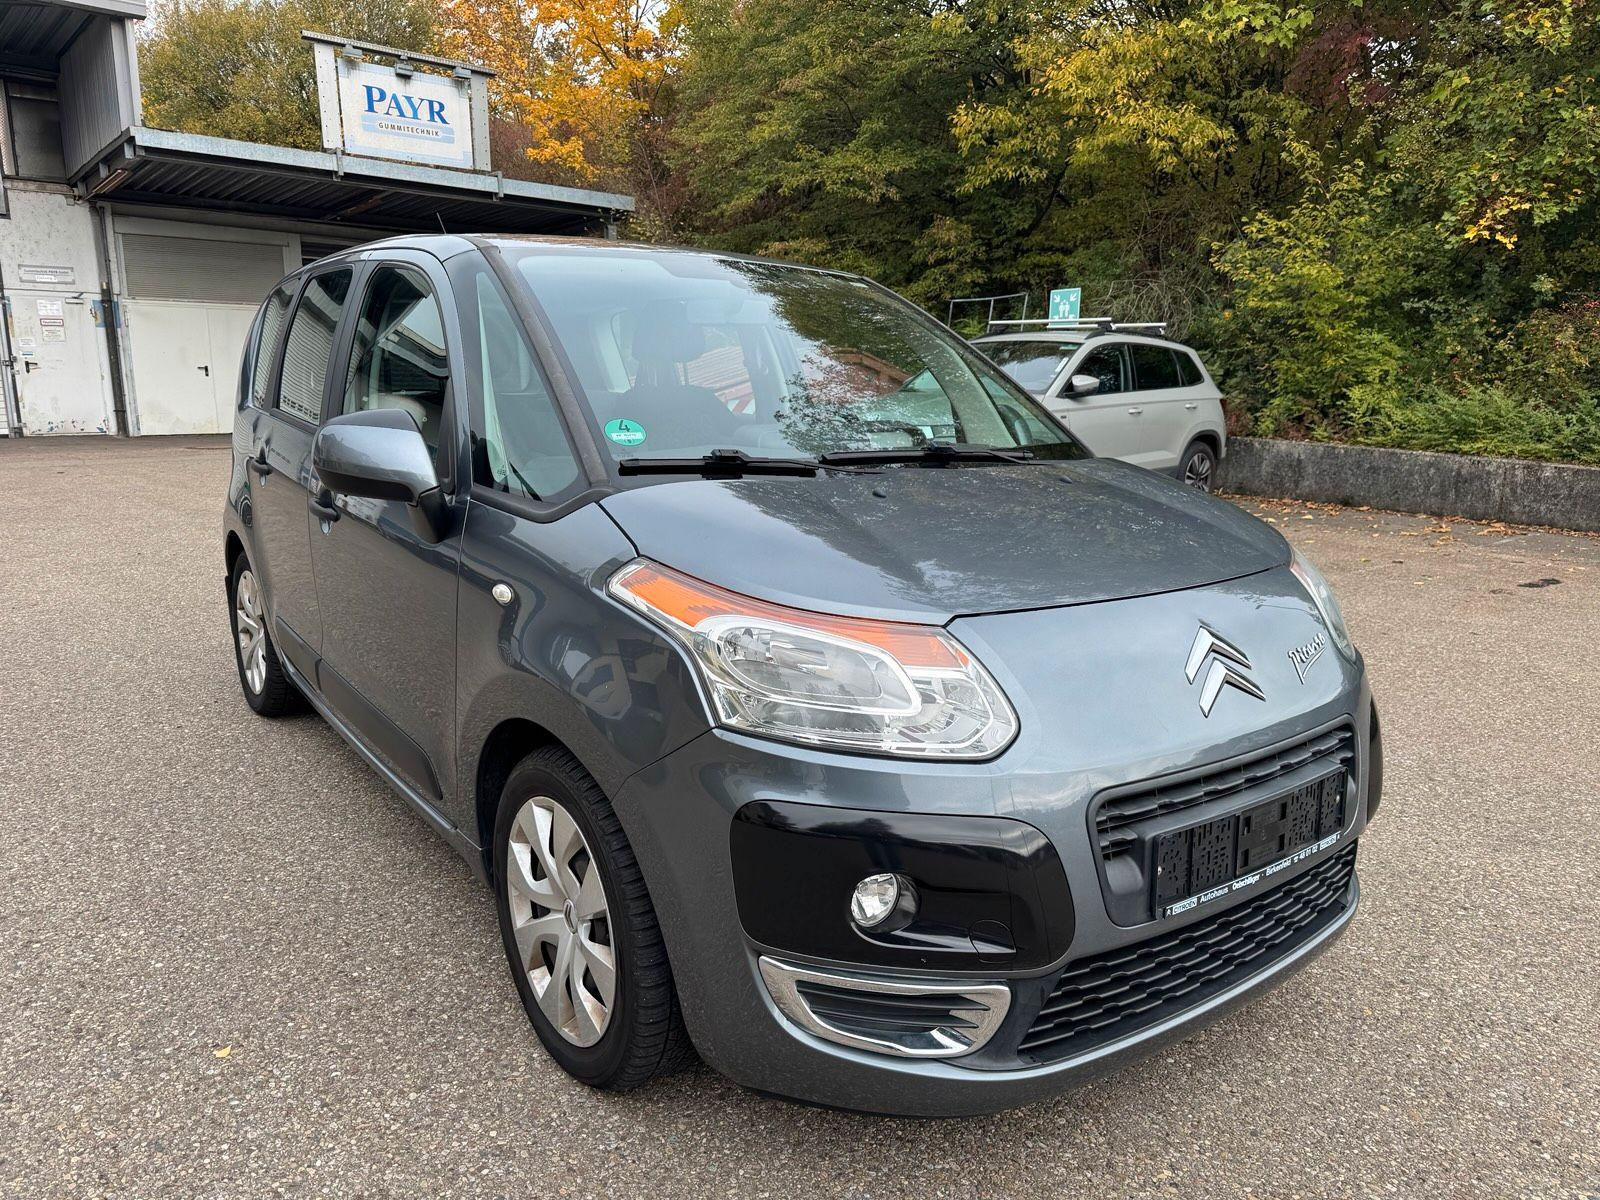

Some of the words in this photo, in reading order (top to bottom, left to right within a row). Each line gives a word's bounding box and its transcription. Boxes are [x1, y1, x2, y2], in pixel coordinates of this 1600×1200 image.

[362, 84, 450, 124] PAYR
[378, 122, 440, 136] GUMMITECHNIK
[618, 419, 631, 433] 4
[1200, 887, 1229, 903] Autohaus
[1266, 858, 1292, 876] Birkenfeld
